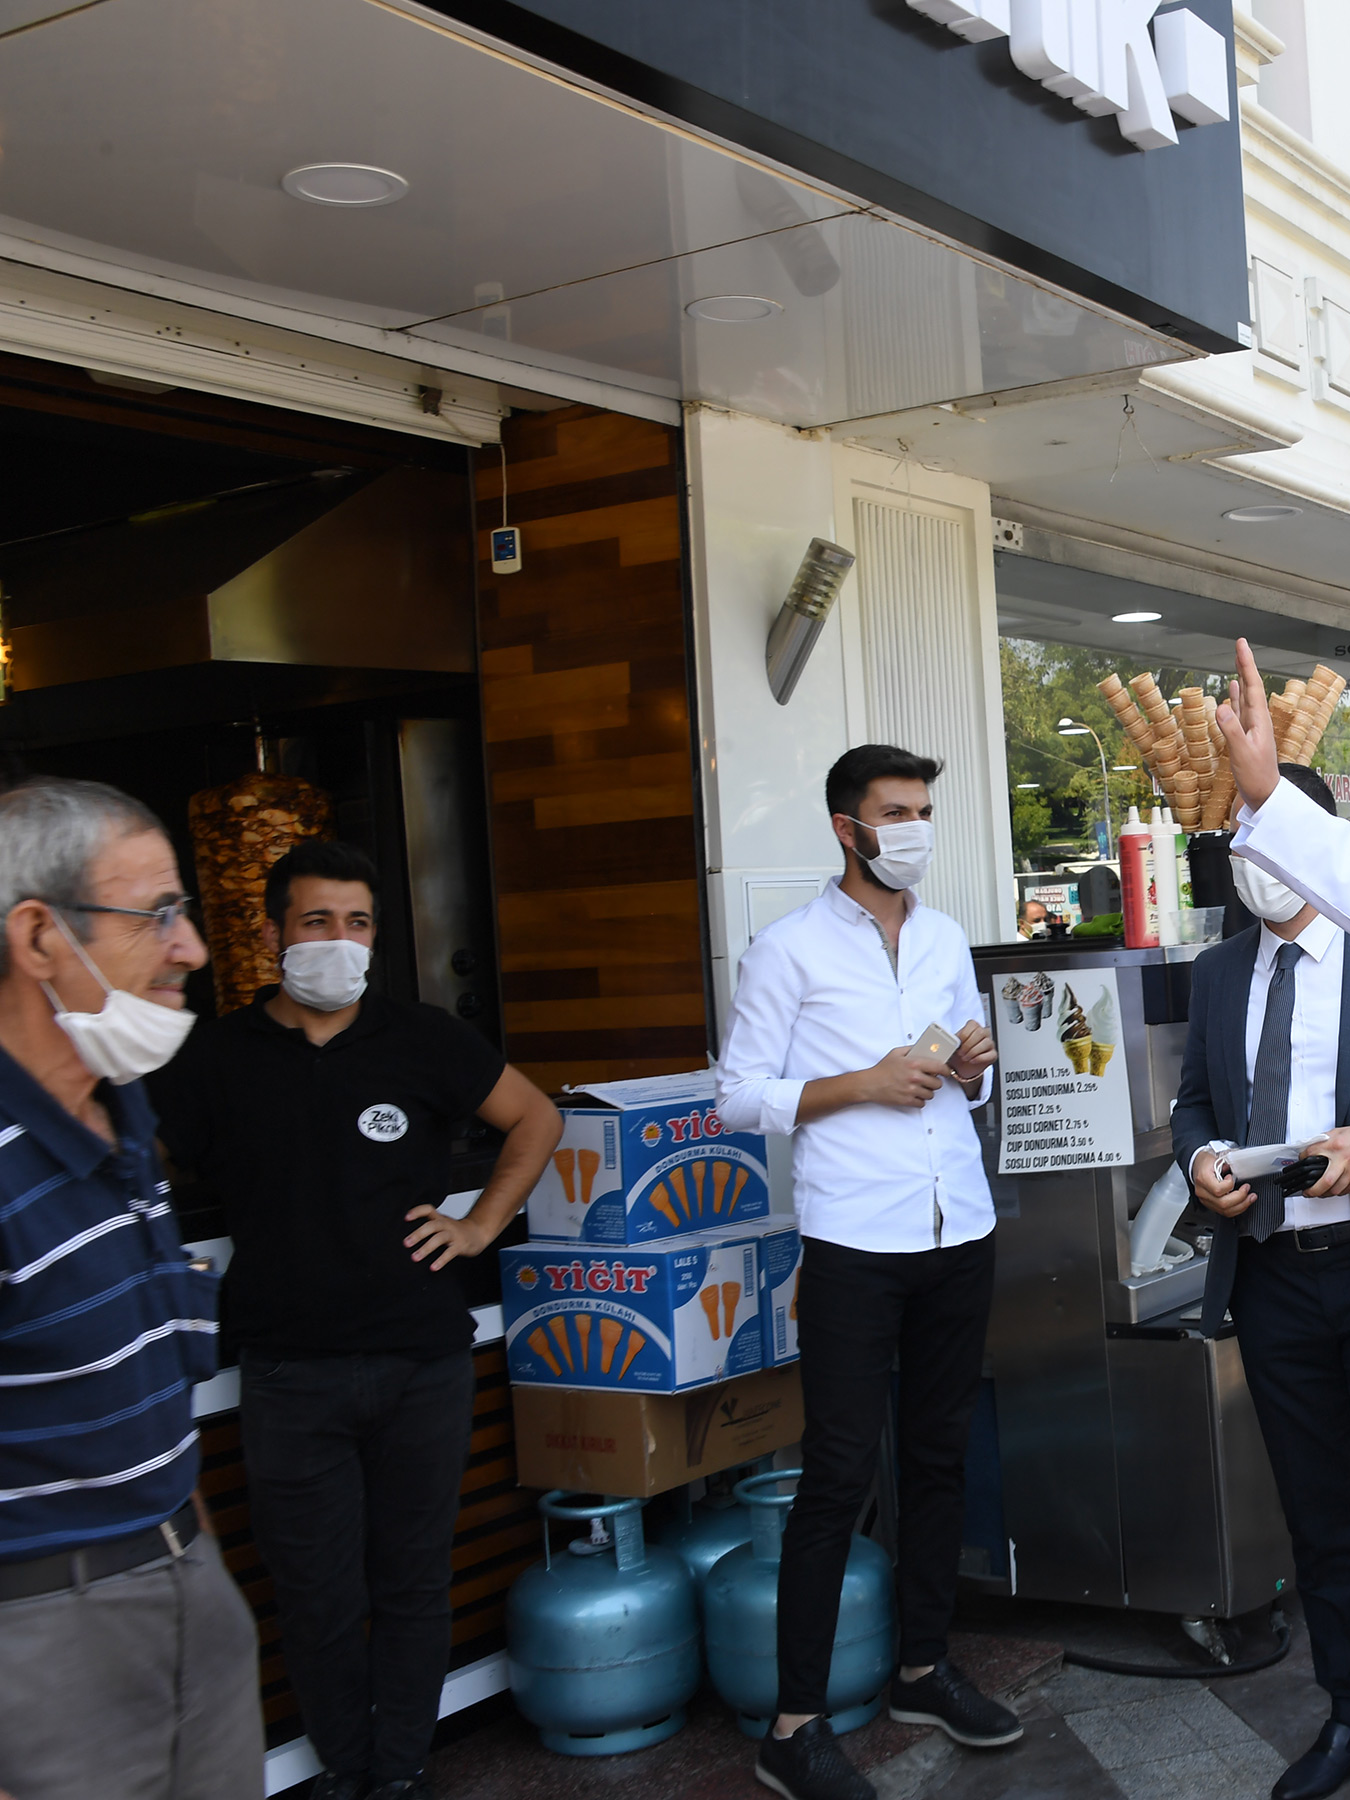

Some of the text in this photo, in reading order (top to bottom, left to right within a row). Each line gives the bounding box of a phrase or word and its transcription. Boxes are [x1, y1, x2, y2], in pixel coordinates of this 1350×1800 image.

[1005, 1068, 1048, 1083] DONDURMA
[1006, 1088, 1031, 1100] SOSLU
[1032, 1083, 1075, 1098] DONDURMA
[1007, 1104, 1037, 1118] CORNET
[666, 1106, 735, 1142] YİĞ
[1007, 1122, 1031, 1135] SOSLU
[1033, 1119, 1063, 1132] CORNET
[1007, 1140, 1022, 1153] CUP
[1024, 1136, 1068, 1151] DONDURMA
[655, 1149, 706, 1173] DONDURMA
[1005, 1157, 1031, 1169] SOSLU
[1033, 1156, 1048, 1168] CUP
[1050, 1152, 1095, 1166] DONDURMA
[543, 1260, 652, 1293] YİĞİT
[533, 1301, 591, 1318] DONDURMA
